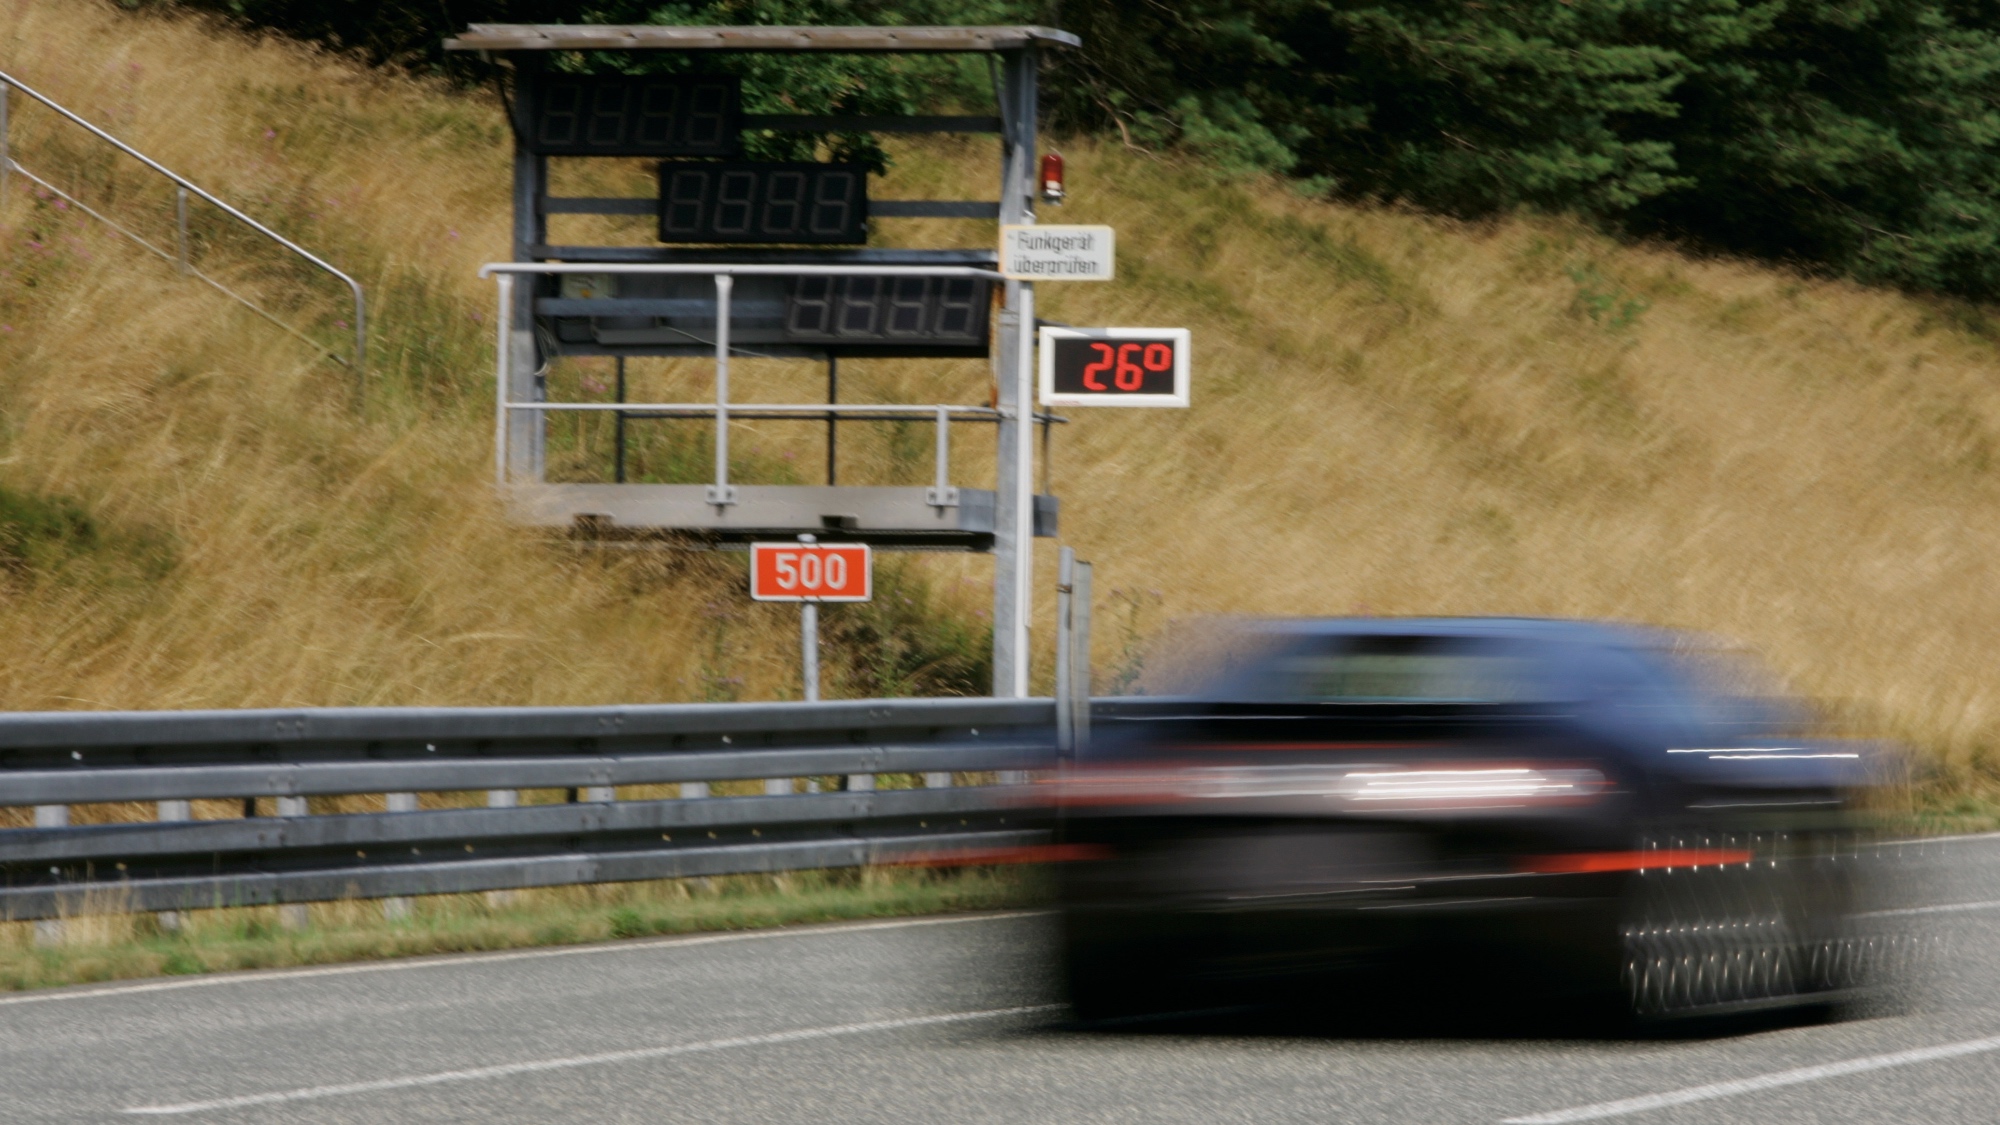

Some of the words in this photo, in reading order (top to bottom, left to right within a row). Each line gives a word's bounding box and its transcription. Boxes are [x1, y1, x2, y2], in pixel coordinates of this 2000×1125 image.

[1018, 231, 1095, 254] Funkgerät
[1013, 254, 1098, 276] überprüfen
[1083, 342, 1172, 391] 26°
[775, 552, 848, 590] 500
